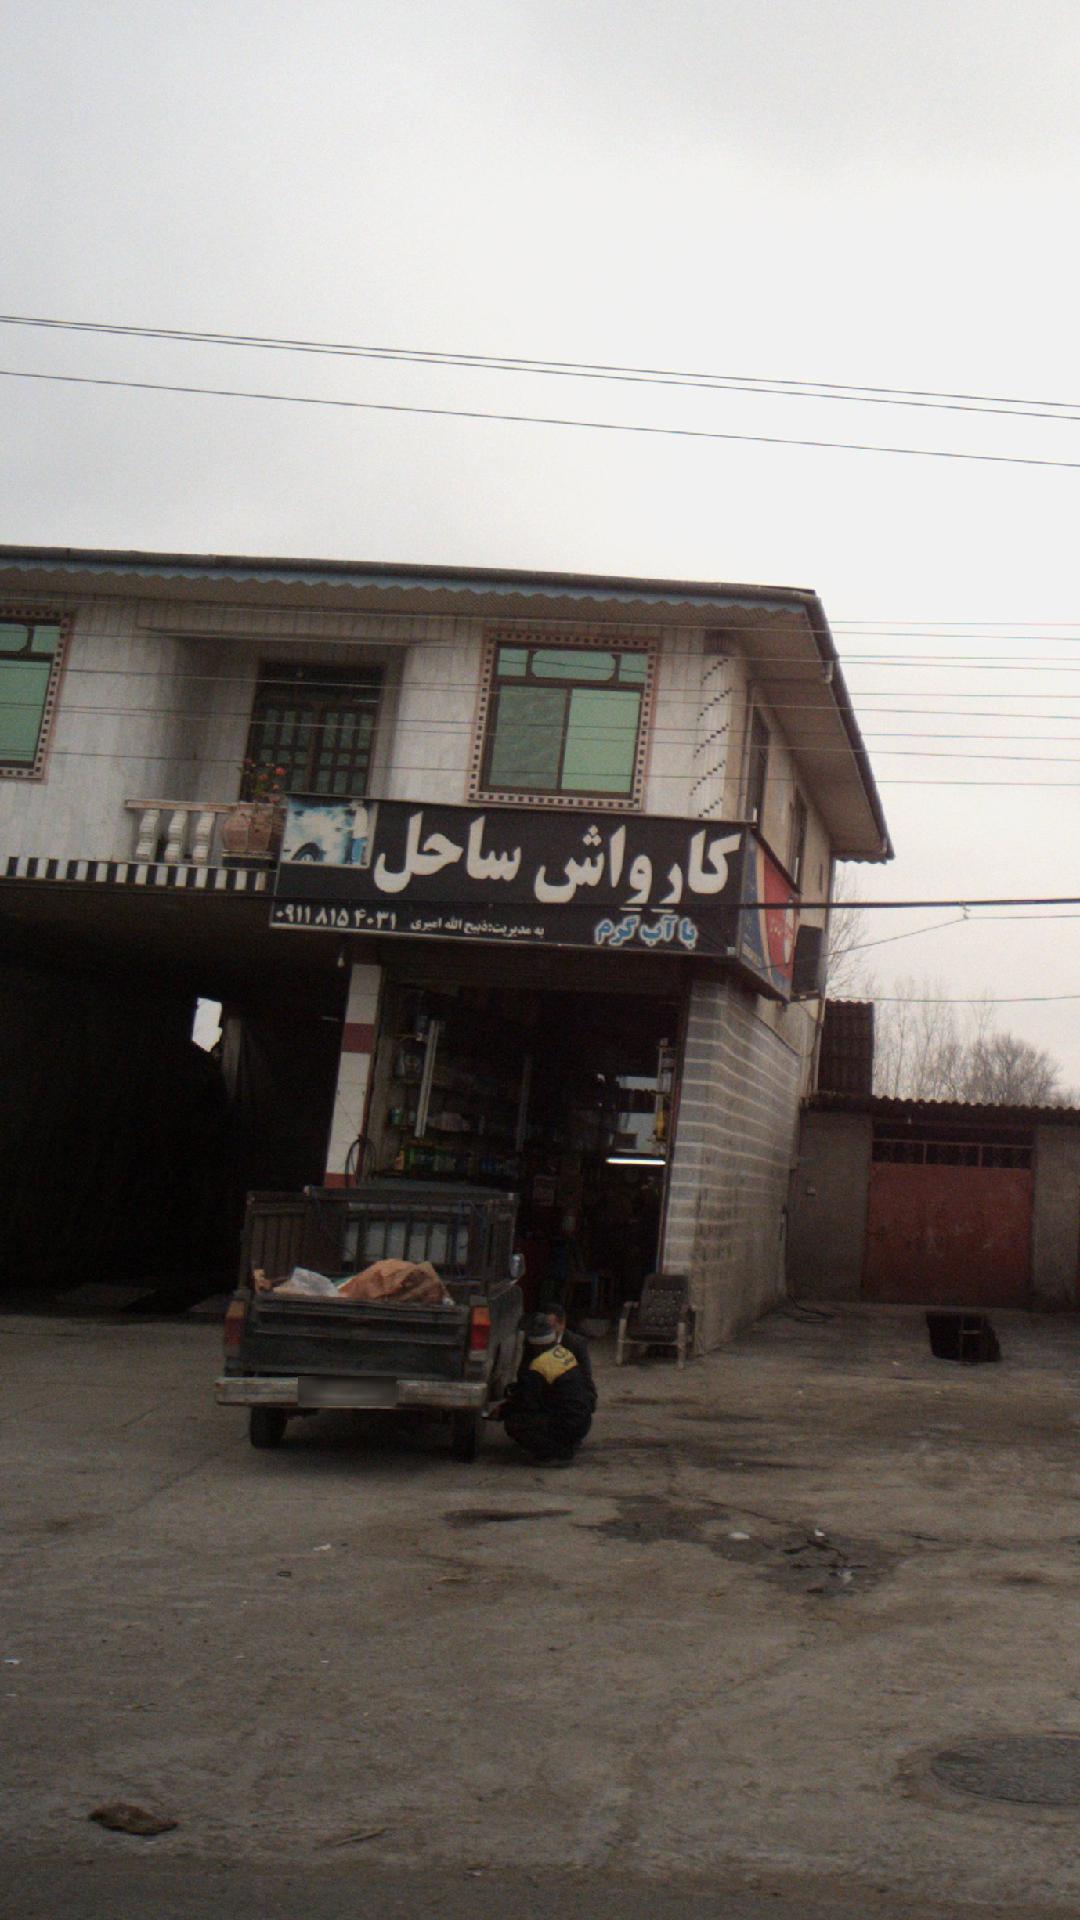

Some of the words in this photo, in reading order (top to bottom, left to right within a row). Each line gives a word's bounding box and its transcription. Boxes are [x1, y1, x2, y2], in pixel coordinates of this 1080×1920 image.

[373, 811, 522, 893] ساحل
[276, 904, 310, 923] ۰۹۱۱
[315, 907, 349, 927] ۸۱۵
[355, 909, 397, 930] ۴۰۳۱
[595, 914, 640, 946] گرم
[640, 915, 679, 947] آب
[679, 918, 698, 949] با
